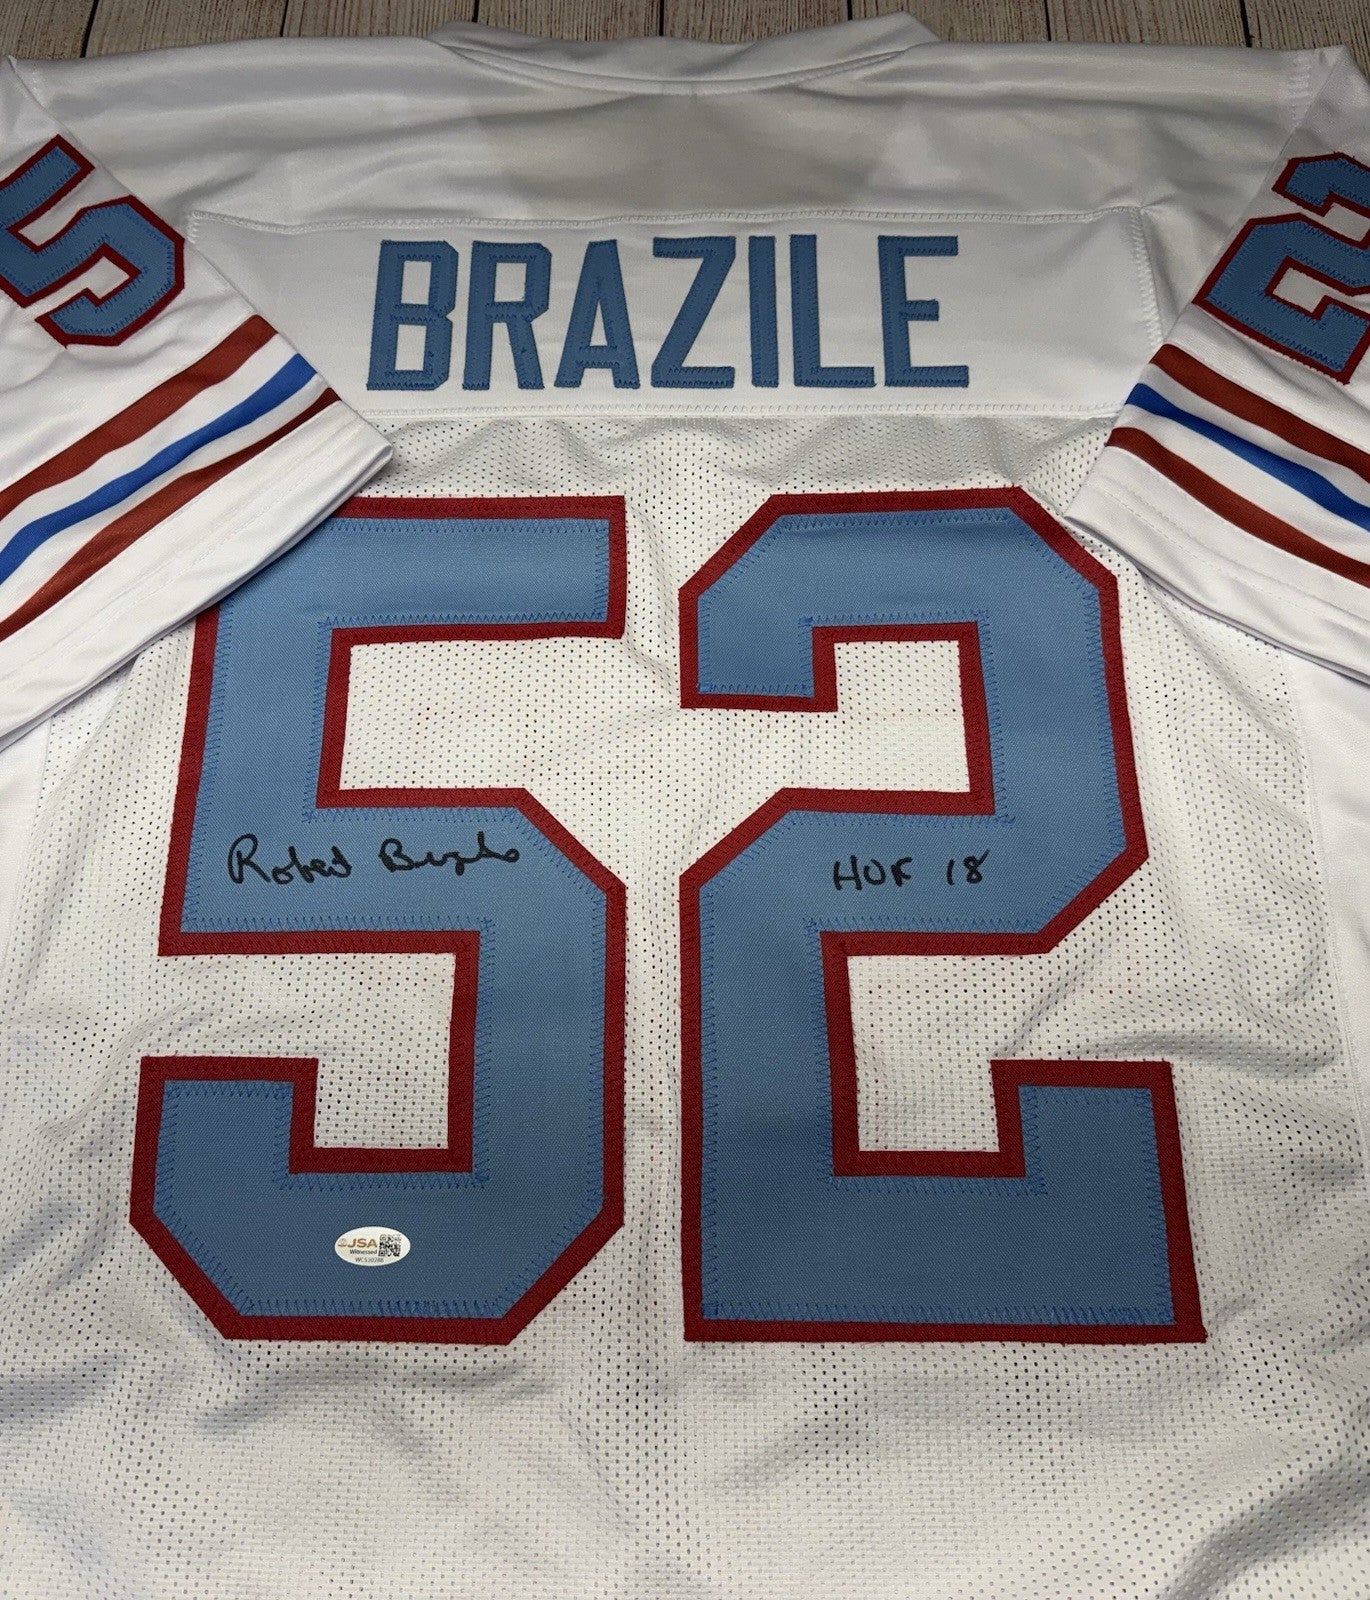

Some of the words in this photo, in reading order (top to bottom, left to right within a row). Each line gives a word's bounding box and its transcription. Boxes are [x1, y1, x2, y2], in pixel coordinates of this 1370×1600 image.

[0, 134, 185, 348] 5
[366, 234, 969, 390] BRAZILE
[1192, 152, 1370, 385] 2
[130, 487, 1206, 1344] 52
[946, 849, 990, 886] 18
[348, 1238, 378, 1248] JSA
